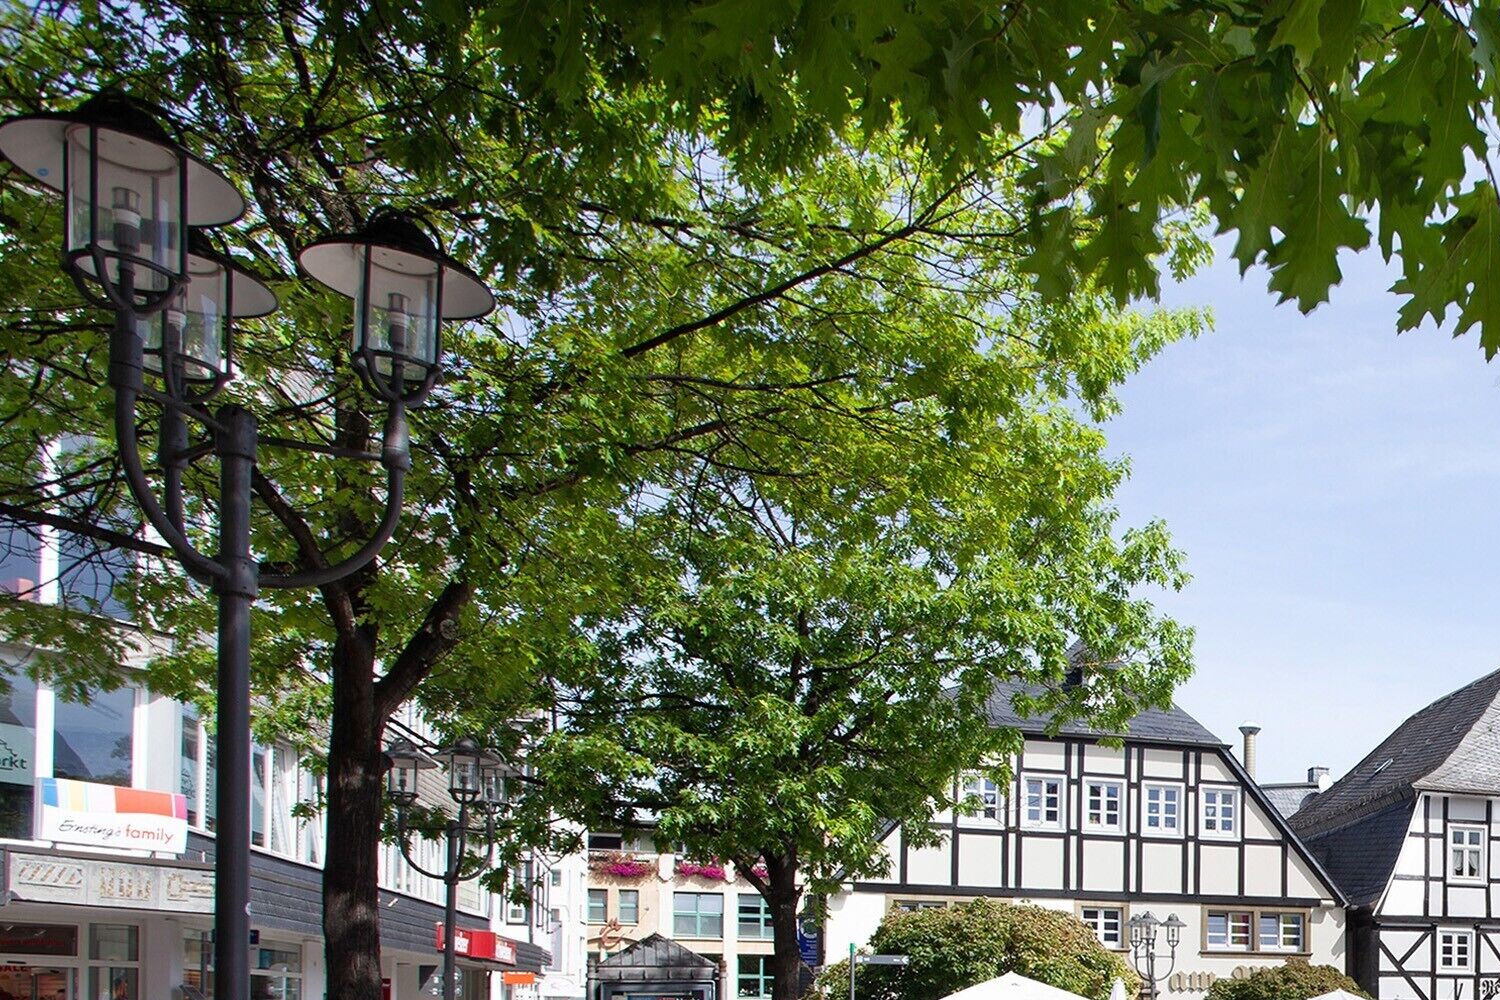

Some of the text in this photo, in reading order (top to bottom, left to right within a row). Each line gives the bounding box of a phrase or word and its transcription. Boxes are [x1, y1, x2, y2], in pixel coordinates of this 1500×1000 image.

[0, 756, 27, 769] rkt
[59, 819, 175, 844] Ernsting's family
